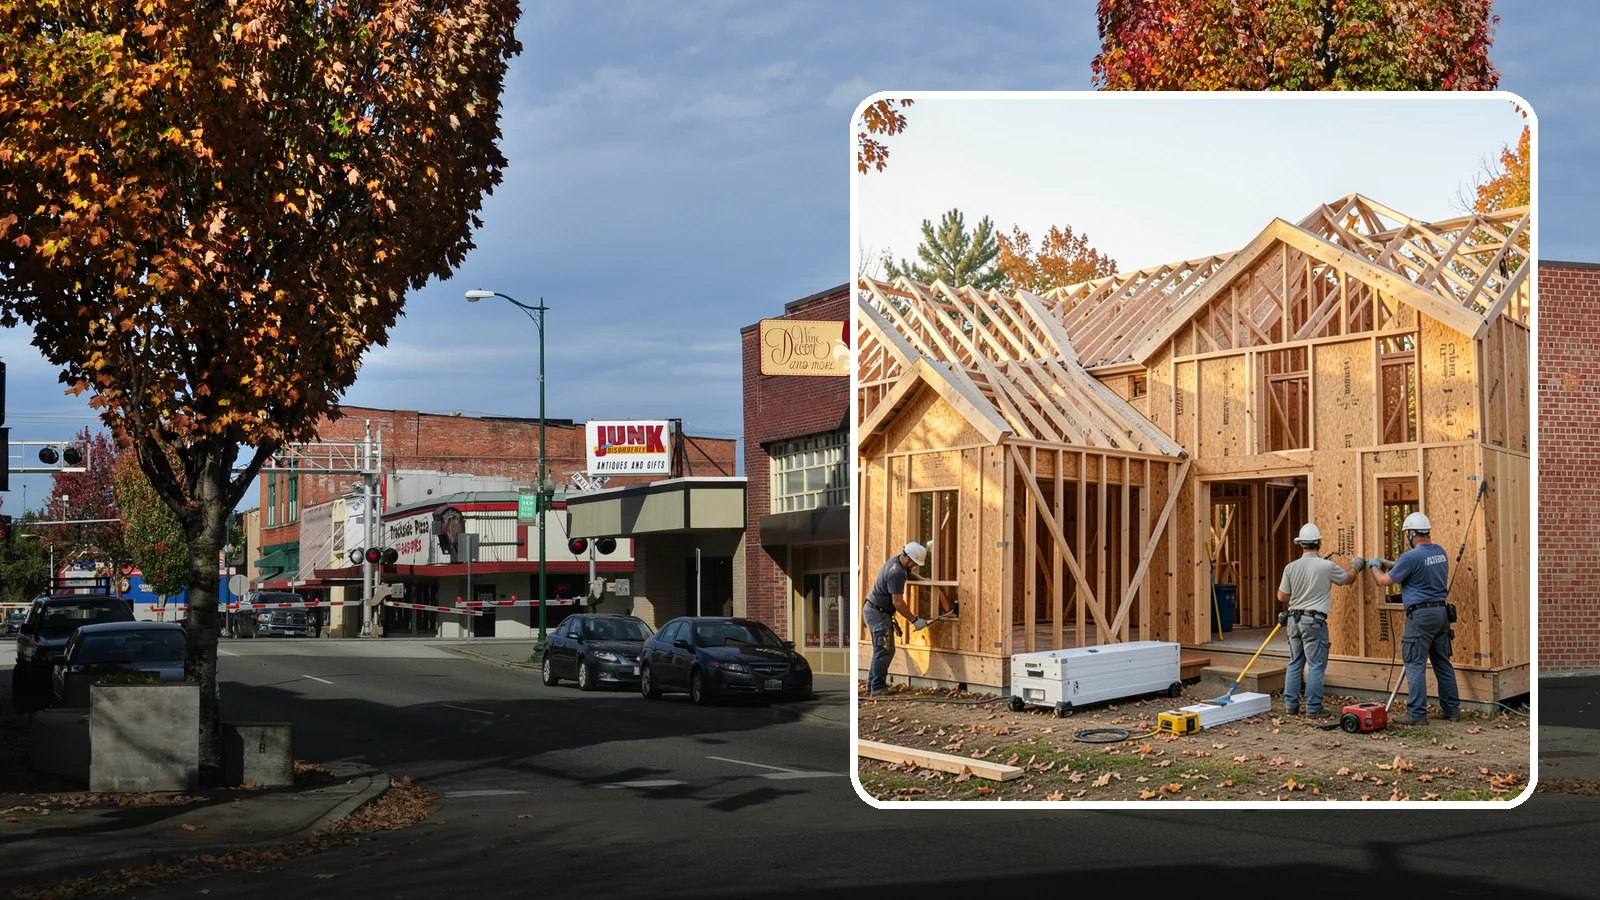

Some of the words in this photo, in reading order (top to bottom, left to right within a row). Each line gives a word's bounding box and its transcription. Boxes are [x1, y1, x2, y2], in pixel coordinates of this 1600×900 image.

[595, 425, 665, 457] JUNK
[607, 446, 646, 454] DISORDERLY
[596, 461, 628, 470] ANTIQUES
[630, 460, 644, 470] AND
[647, 460, 666, 470] GIFTS
[414, 519, 429, 535] Pizza
